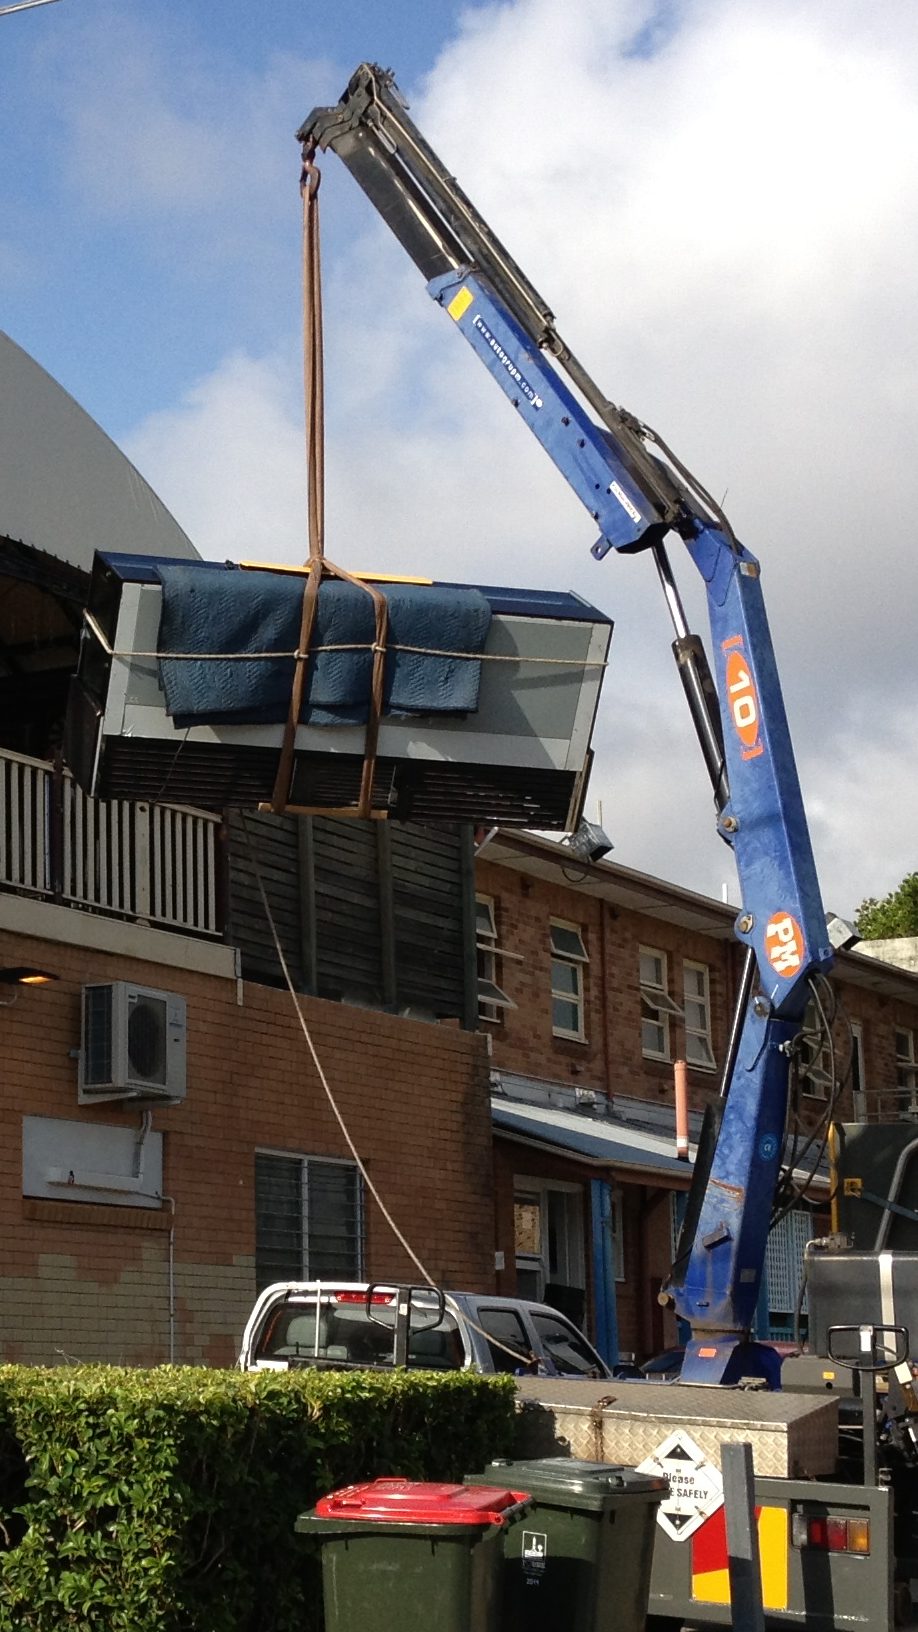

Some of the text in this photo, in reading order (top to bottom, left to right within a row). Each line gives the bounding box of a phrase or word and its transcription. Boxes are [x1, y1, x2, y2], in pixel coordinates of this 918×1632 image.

[730, 670, 756, 728] 10
[767, 917, 800, 972] PM
[662, 1472, 695, 1485] Please
[677, 1488, 708, 1499] SAFELY
